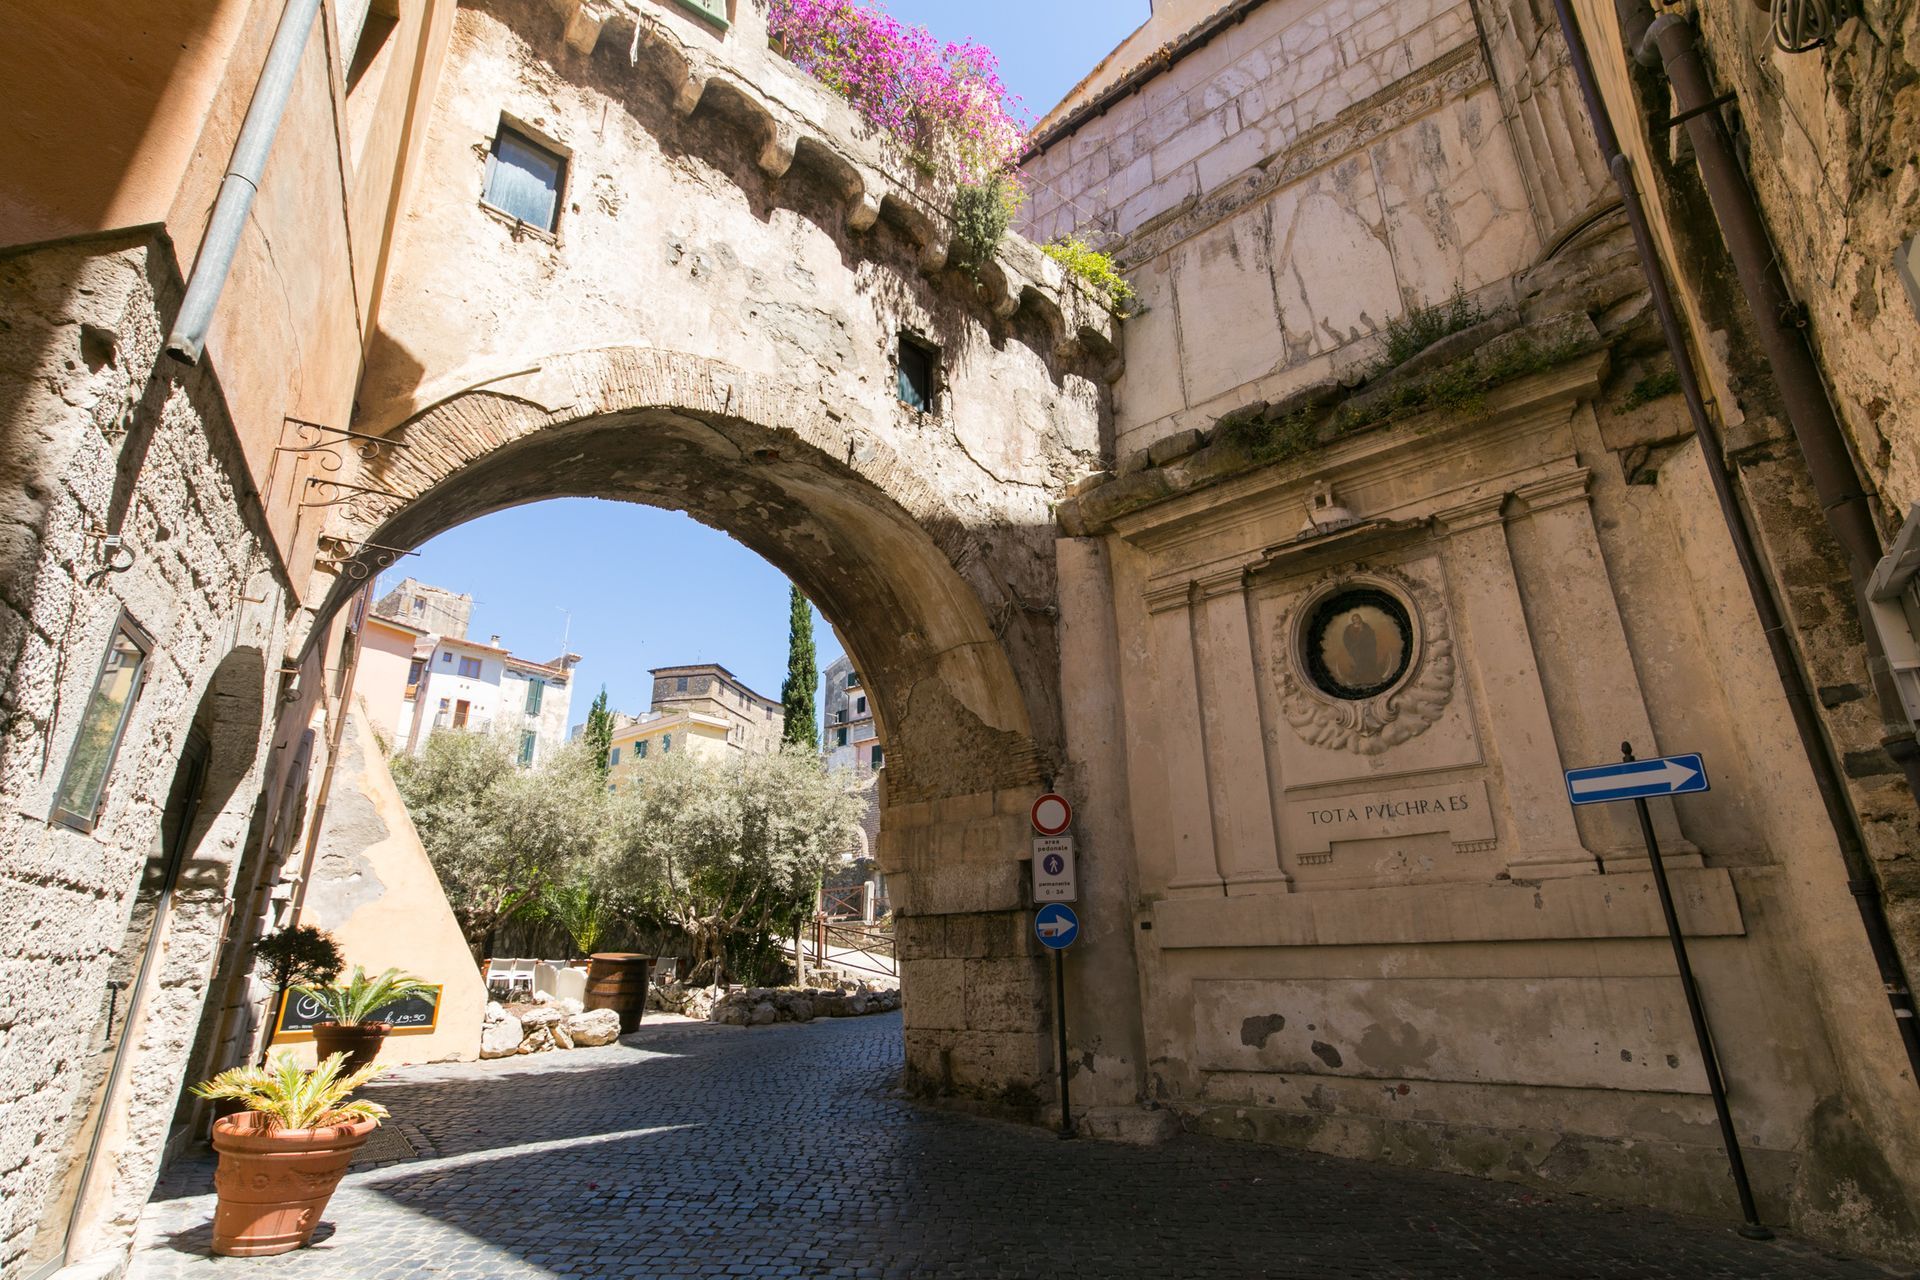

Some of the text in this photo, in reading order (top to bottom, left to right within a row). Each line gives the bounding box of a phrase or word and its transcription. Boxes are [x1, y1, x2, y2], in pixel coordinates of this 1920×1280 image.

[1307, 794, 1469, 825] TOTA PVLCHRA ES
